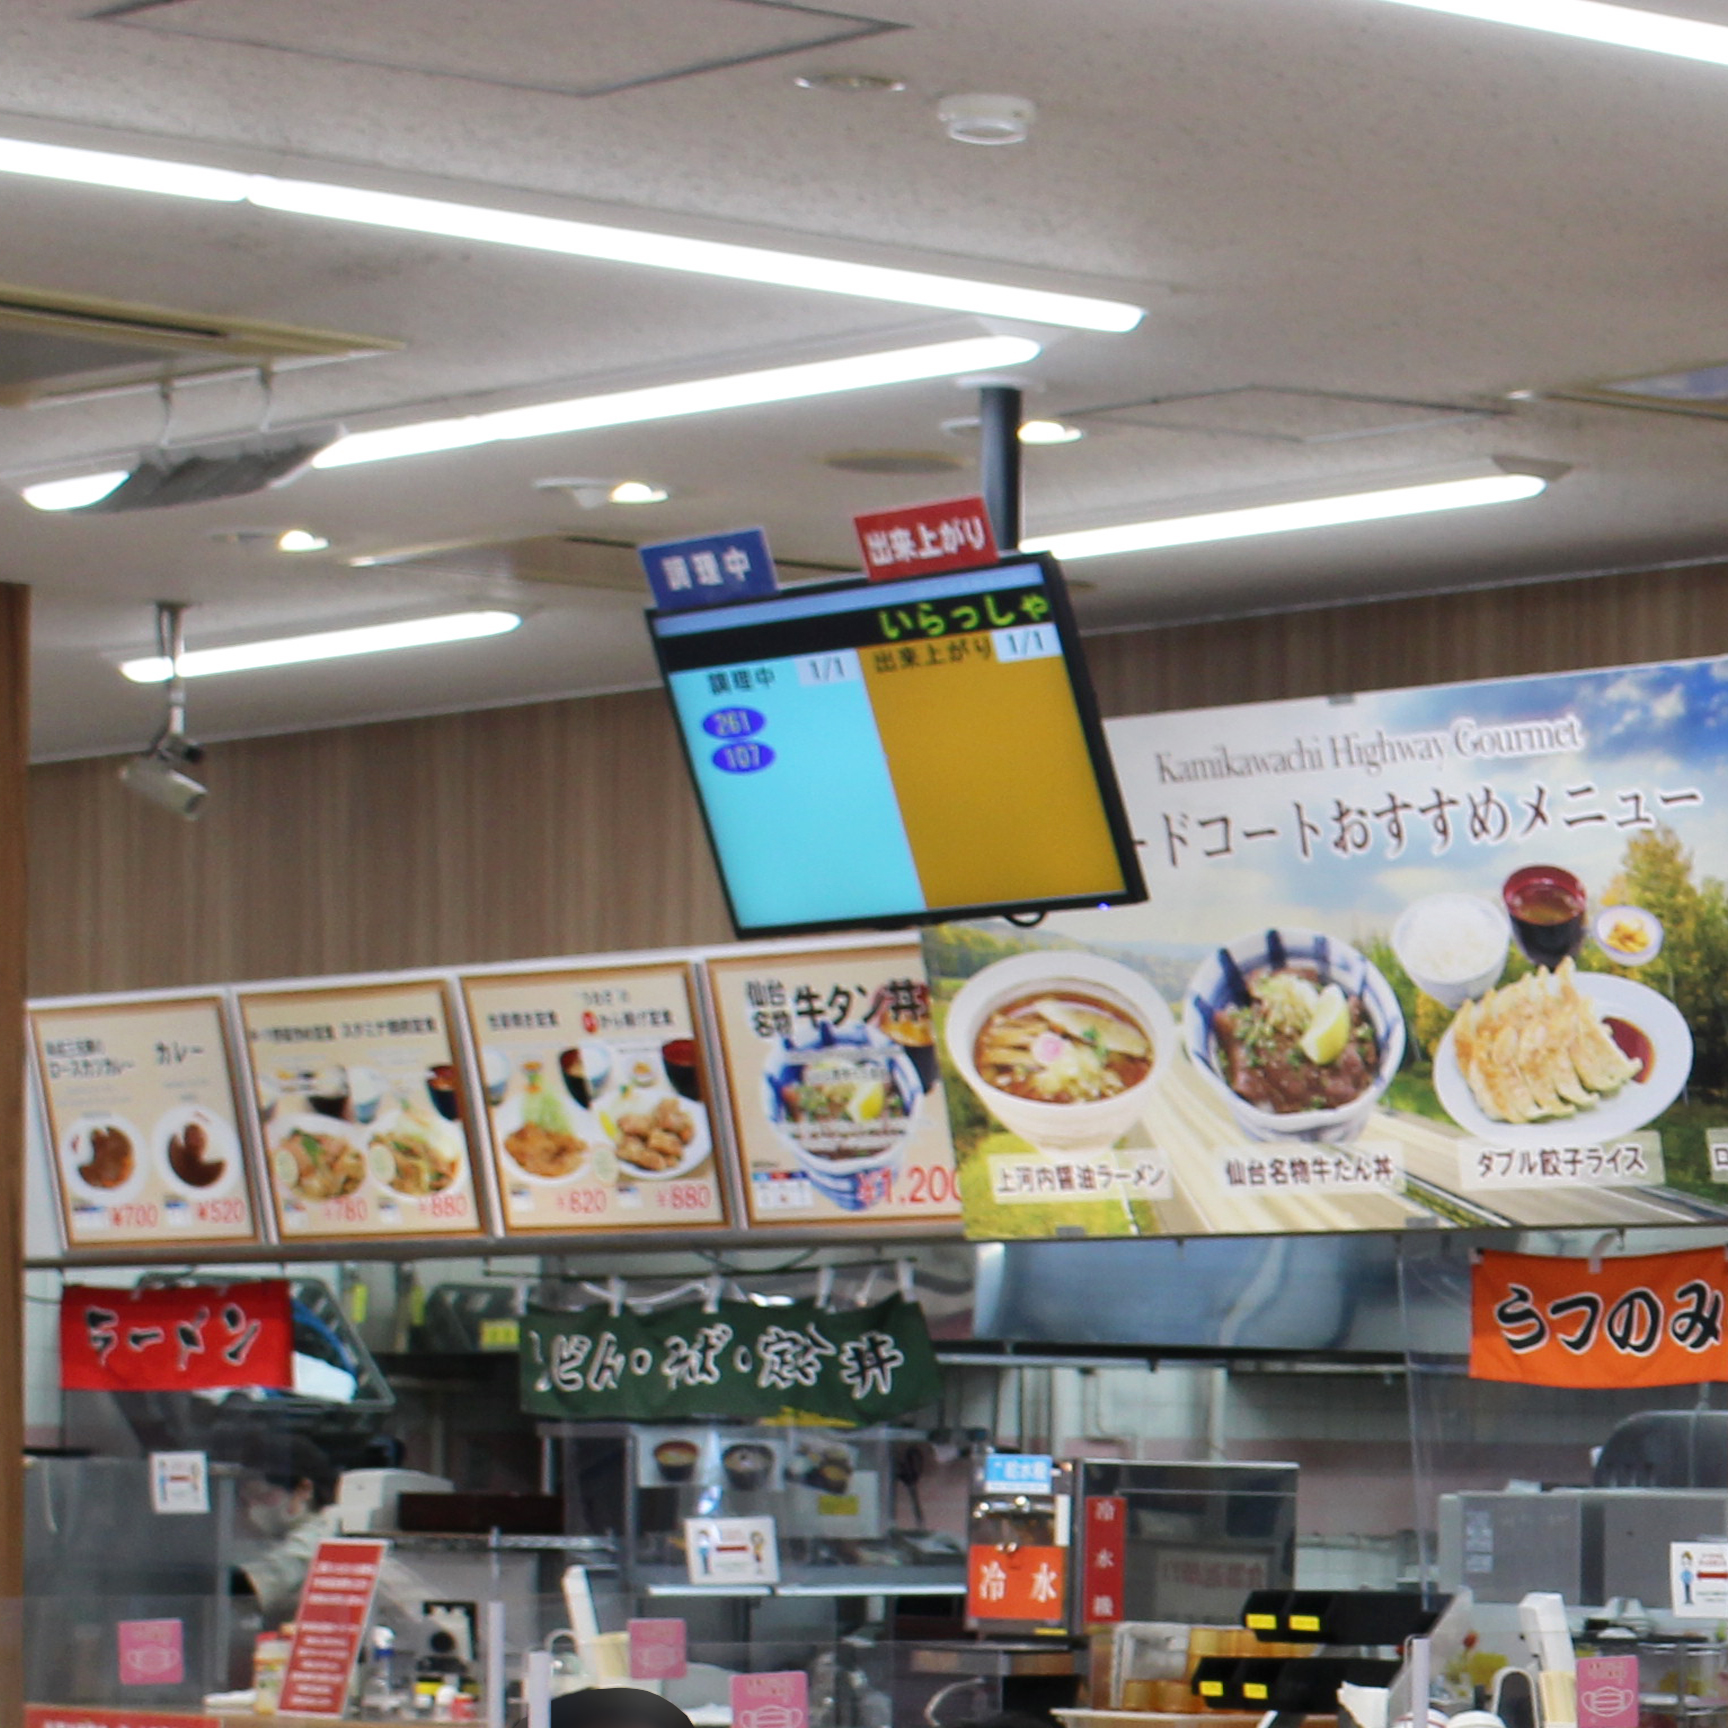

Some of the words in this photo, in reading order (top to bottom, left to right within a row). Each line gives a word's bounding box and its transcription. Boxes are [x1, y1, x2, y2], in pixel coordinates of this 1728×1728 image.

[864, 516, 988, 568] 出来上がり
[661, 547, 752, 593] 調理中
[872, 637, 992, 674] 出来上がり
[708, 668, 776, 698] 調理中
[712, 711, 752, 735] 261
[722, 745, 762, 770] 107
[1156, 732, 1326, 785] Kamikawachi
[1329, 725, 1448, 779] Highway
[1453, 714, 1583, 760] Gourmet
[153, 1039, 206, 1066] カレー
[1225, 1154, 1395, 1187] 仙台名物牛たん丼
[1475, 1144, 1646, 1178] ダブル餃子ライス
[998, 1162, 1167, 1195] 上河内醤油ラーメン
[84, 1302, 262, 1372] ラーメン
[979, 1559, 1058, 1604] 冷水
